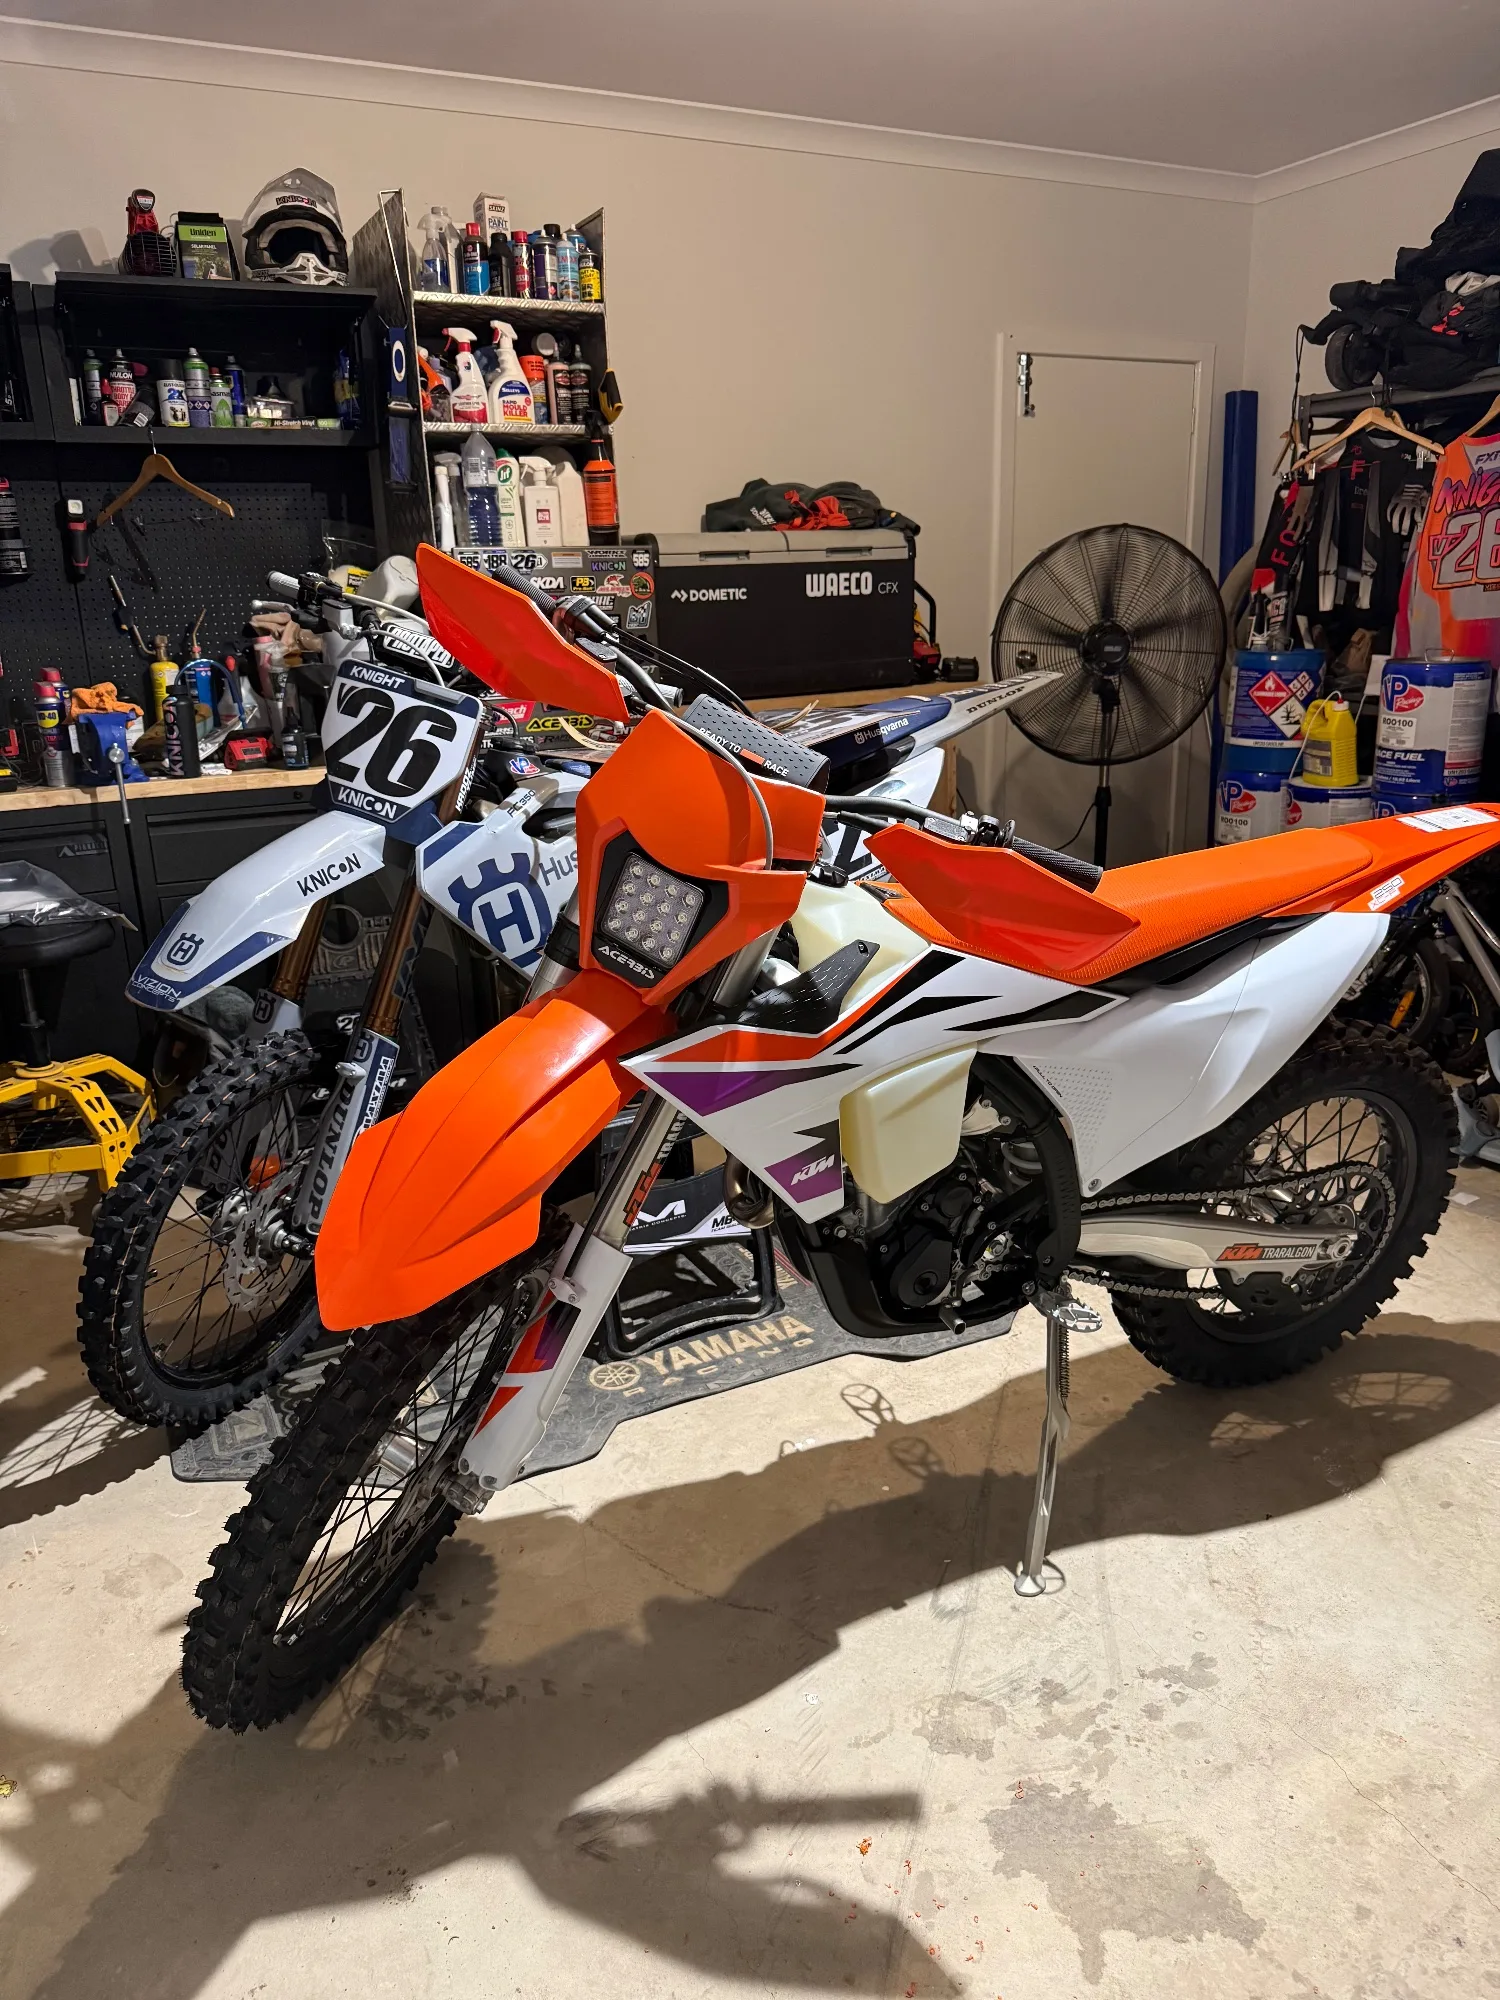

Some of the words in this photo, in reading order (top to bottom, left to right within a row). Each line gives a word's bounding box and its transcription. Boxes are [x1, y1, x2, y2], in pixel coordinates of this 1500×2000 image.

[190, 228, 217, 237] Uniden
[488, 218, 509, 229] PAINT
[109, 371, 133, 380] NULON
[167, 387, 185, 399] 2X
[274, 419, 301, 427] Hi-Stretch
[500, 467, 512, 481] Jif
[513, 553, 537, 570] 26
[632, 553, 650, 567] 585
[530, 576, 565, 590] SKDA
[689, 588, 748, 601] DOMETIC
[805, 571, 873, 598] WAECO
[877, 581, 899, 595] CFX
[349, 665, 406, 690] KNIGHT
[965, 685, 1026, 714] DUNLOP
[1383, 674, 1410, 712] VP
[37, 711, 57, 722] WD-40
[863, 716, 910, 741] Husqvarna
[325, 686, 458, 799] 26
[700, 727, 729, 747] READY
[729, 742, 742, 755] TO
[763, 759, 790, 777] RACE
[1393, 752, 1426, 762] FUEL
[1220, 780, 1243, 813] VP
[598, 945, 655, 980] ACERBIS
[131, 979, 176, 1004] CONCEPTS
[136, 973, 182, 999] VIZION
[307, 1079, 355, 1225] DUNLOP
[790, 1154, 835, 1186] KTM
[624, 1162, 663, 1227] KTM
[1217, 1245, 1262, 1261] KTM
[1261, 1246, 1314, 1259] TRARALGON
[638, 1315, 815, 1377] YAMAHA
